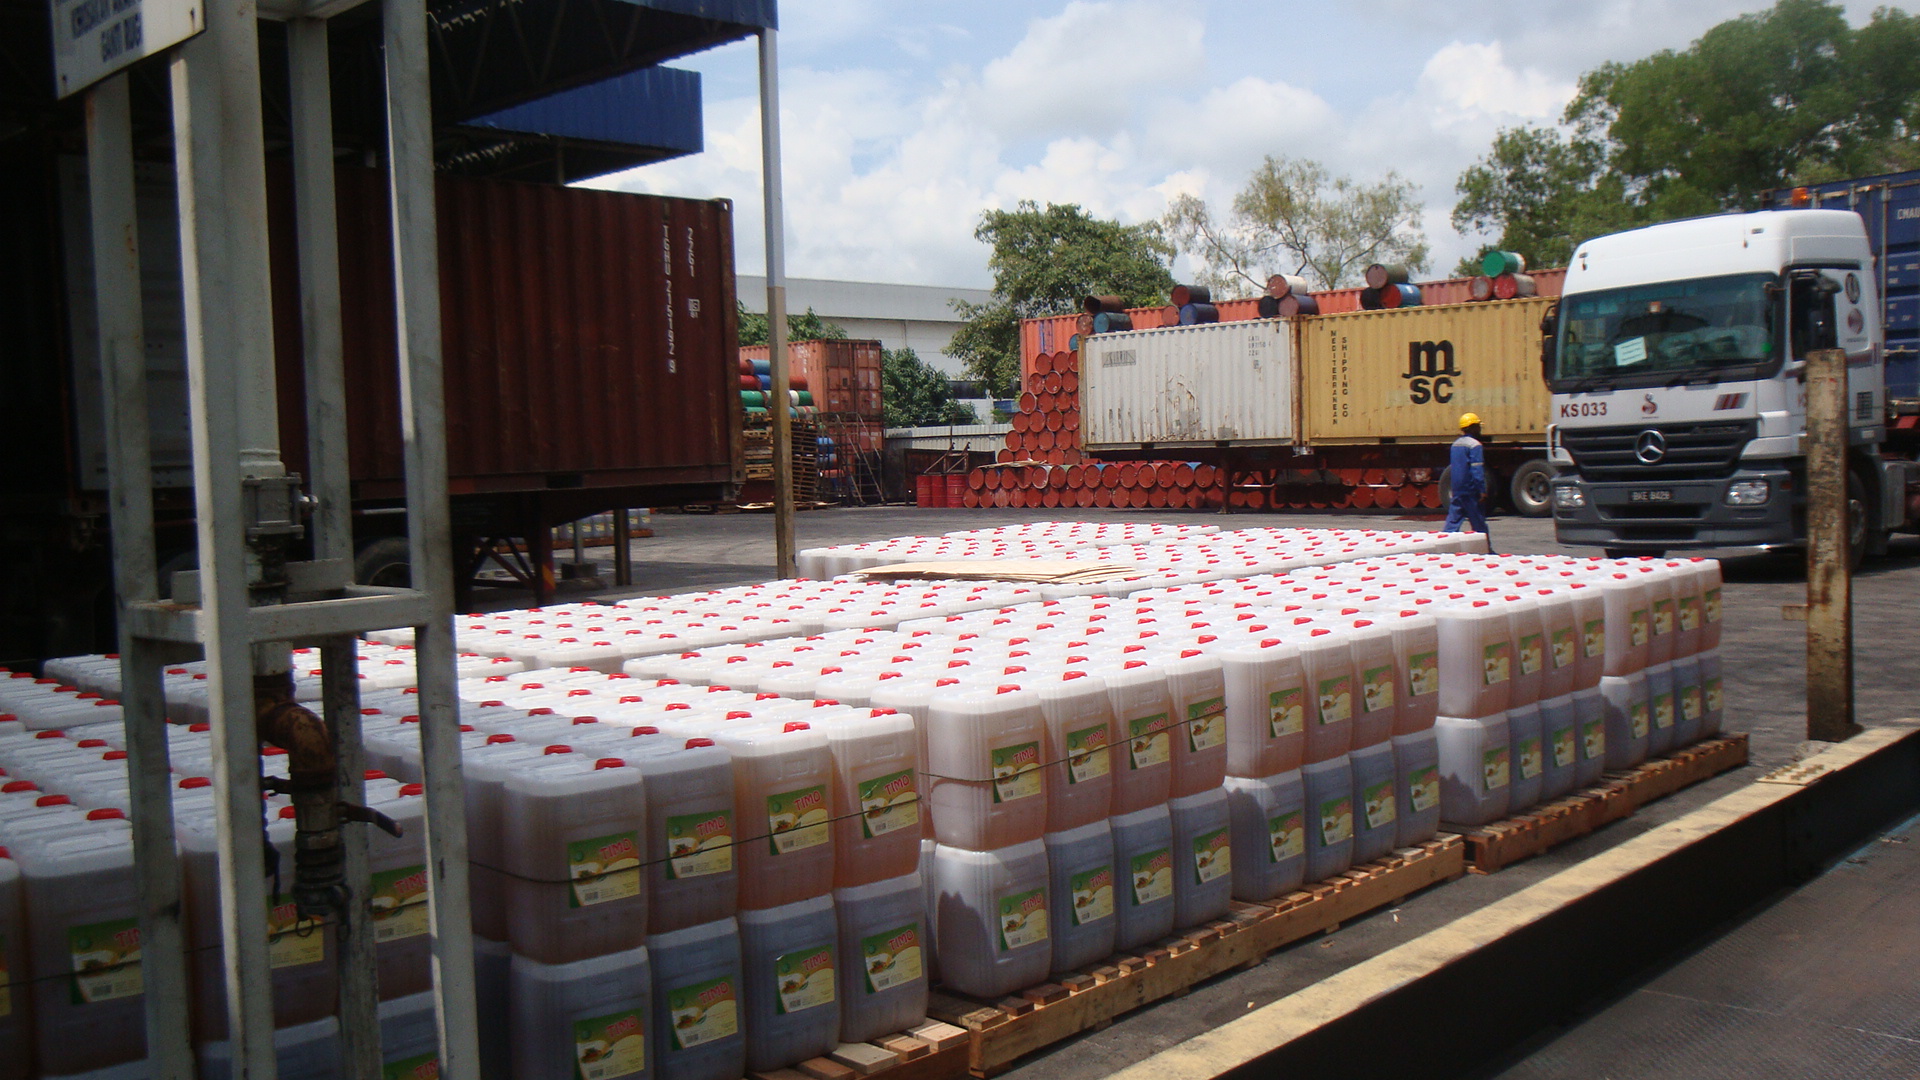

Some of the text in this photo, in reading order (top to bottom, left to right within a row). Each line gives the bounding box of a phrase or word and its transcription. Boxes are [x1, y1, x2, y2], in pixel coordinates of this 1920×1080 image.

[1342, 403, 1348, 418] CO
[1560, 402, 1607, 417] KS 033
[1085, 729, 1105, 746] TIMO
[1013, 746, 1035, 764] TIMO
[884, 774, 910, 795] TIMO
[793, 789, 821, 811] TIMO
[696, 816, 726, 837] TIMO
[599, 837, 631, 860] TIMO
[1090, 871, 1109, 888] TIMO
[1020, 893, 1043, 912] TIMO
[888, 929, 914, 951] TIMO
[802, 951, 829, 972] TIMO
[699, 982, 729, 1005] TIMO
[607, 1015, 638, 1038] TIMO
